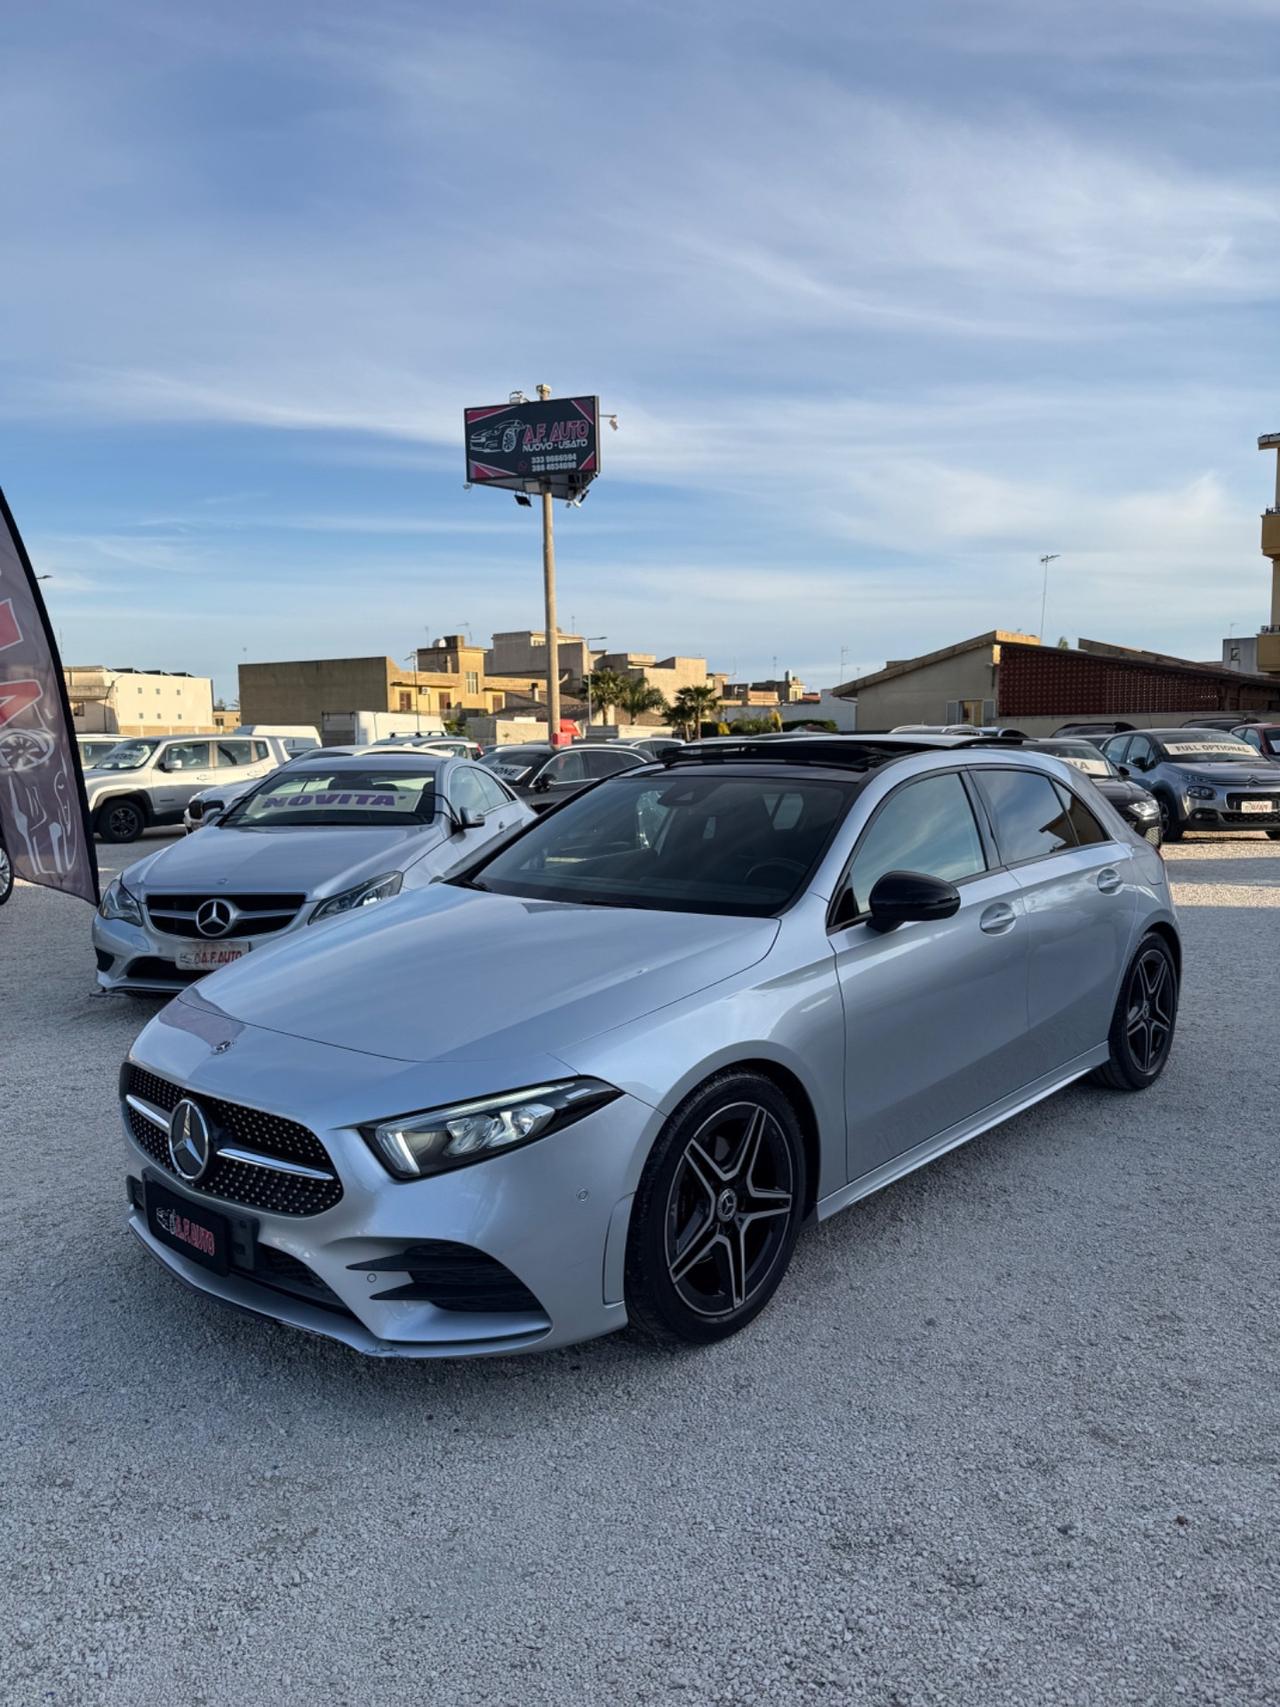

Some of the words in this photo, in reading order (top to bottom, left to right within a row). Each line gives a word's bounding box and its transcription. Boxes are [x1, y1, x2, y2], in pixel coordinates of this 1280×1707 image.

[549, 419, 589, 442] AUTO
[522, 441, 553, 452] NUOVO
[558, 438, 588, 449] USATO
[1175, 744, 1200, 752] FULL
[1202, 744, 1250, 753] OPTIONAL
